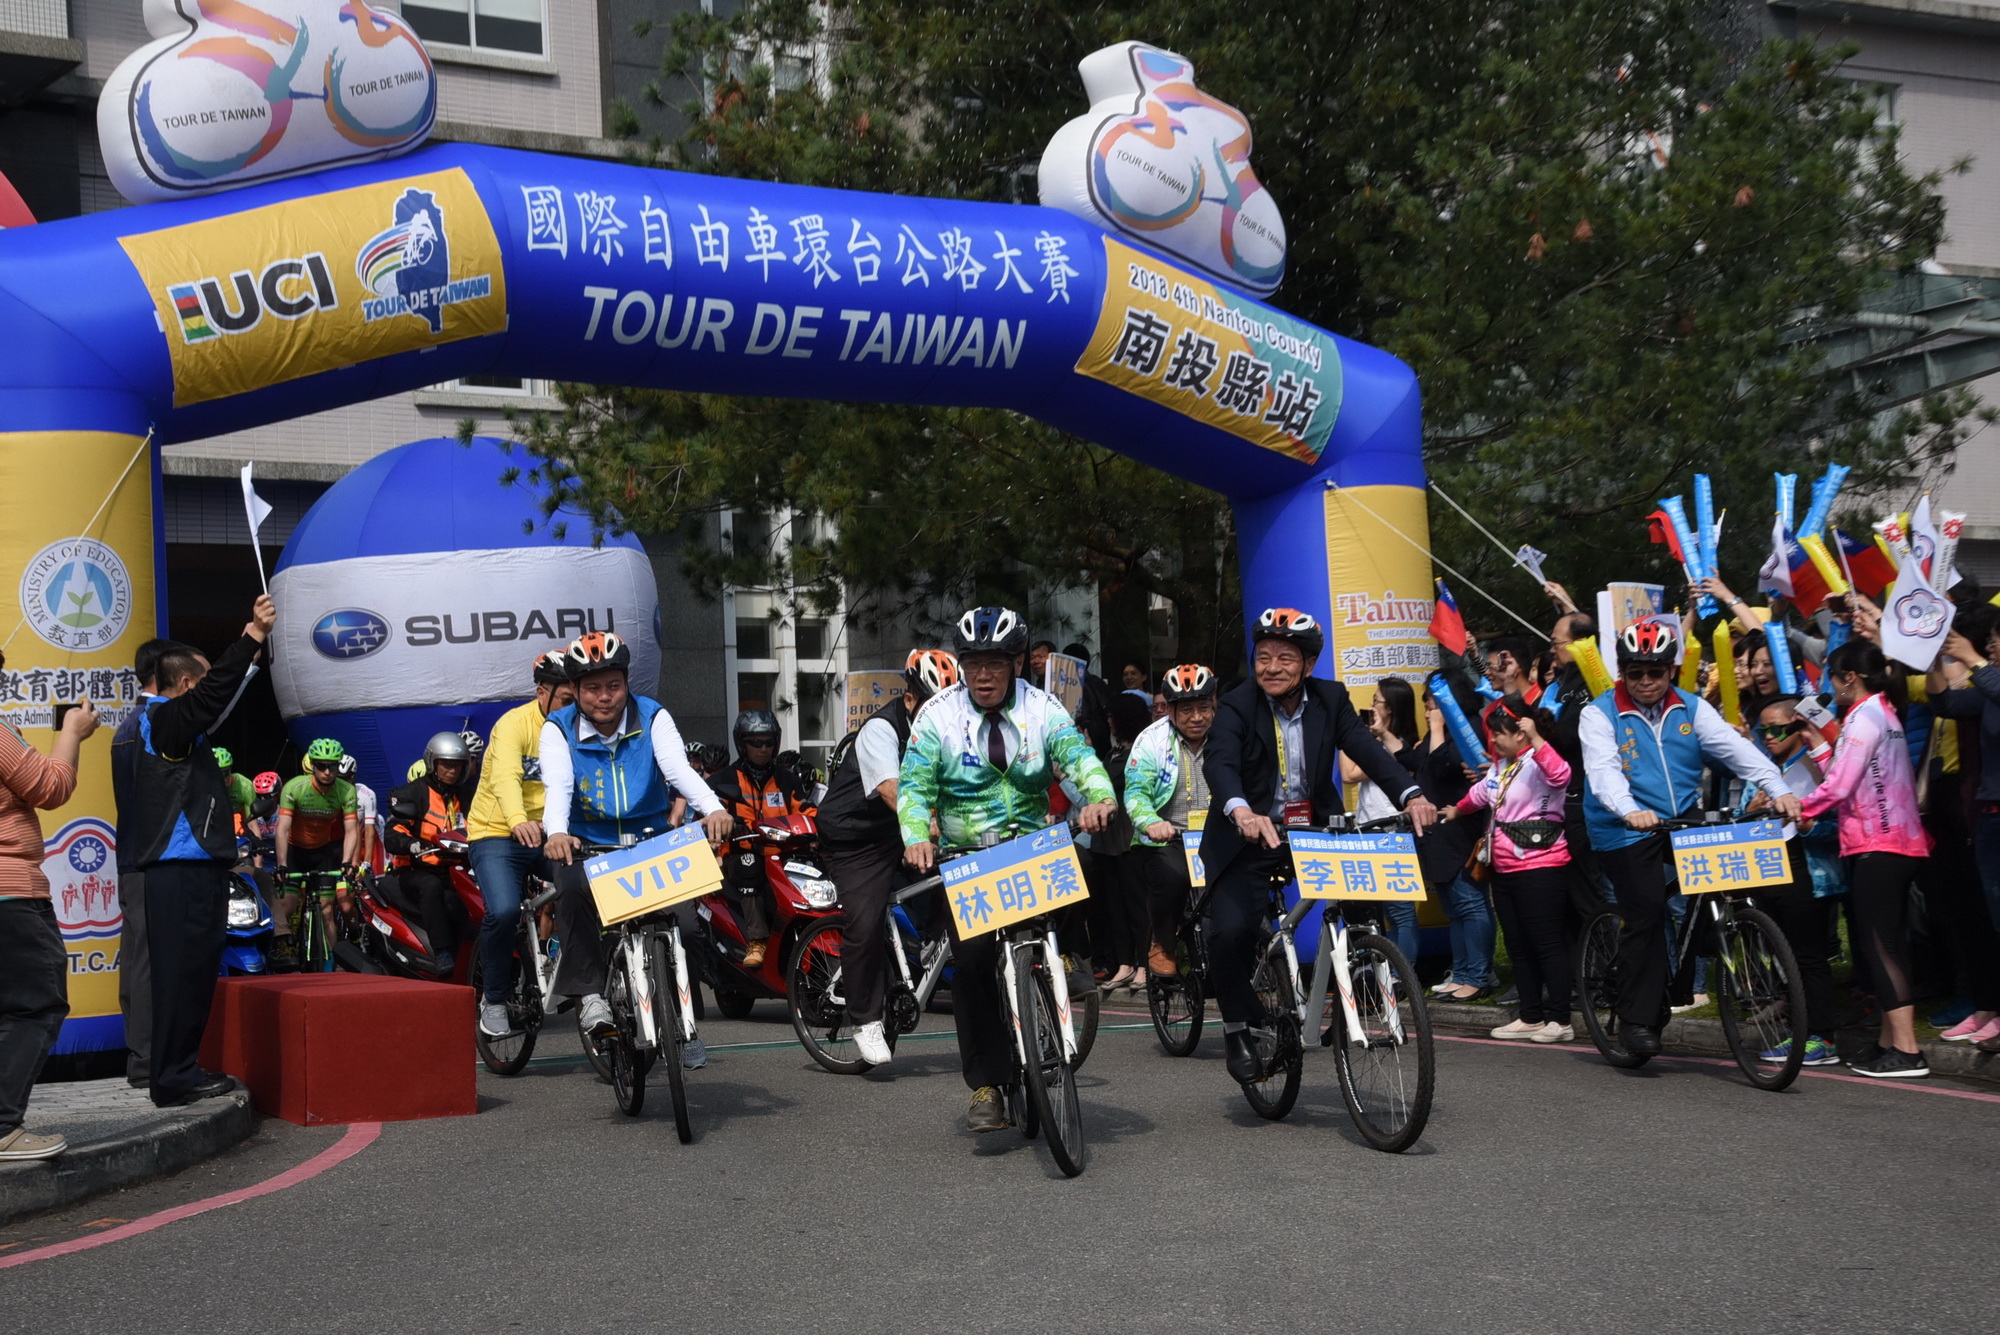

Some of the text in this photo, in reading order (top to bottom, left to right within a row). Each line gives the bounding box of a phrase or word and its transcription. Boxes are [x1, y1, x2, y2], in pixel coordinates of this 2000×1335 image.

[349, 70, 424, 98] TOUR DE TAIWAN
[163, 107, 266, 130] TOUR DE TAIWAN
[1117, 150, 1188, 196] TOUR DE TAIWAN
[1240, 213, 1257, 233] TOUR
[520, 184, 1080, 305] 國際自由車環台公路大賽
[199, 254, 336, 332] UCI
[363, 274, 491, 322] TOUR DE TAIWAN
[583, 285, 1027, 370] TOUR DE TAIWAN
[1130, 265, 1322, 371] 2018 4th Nantou County
[1113, 308, 1320, 437] 南投縣站
[27, 545, 127, 627] MINISTRY OF EDUCATION
[48, 623, 112, 647] 教育部
[405, 607, 615, 647] SUBARU
[1368, 630, 1384, 639] THE
[1386, 629, 1408, 638] HEART
[1871, 758, 1881, 780] Tour
[1288, 815, 1309, 824] OFFICIAL
[616, 856, 691, 899] VIP
[944, 862, 980, 882] 南投縣長
[1300, 859, 1420, 893] 李開志
[1681, 847, 1785, 887] 洪瑞智
